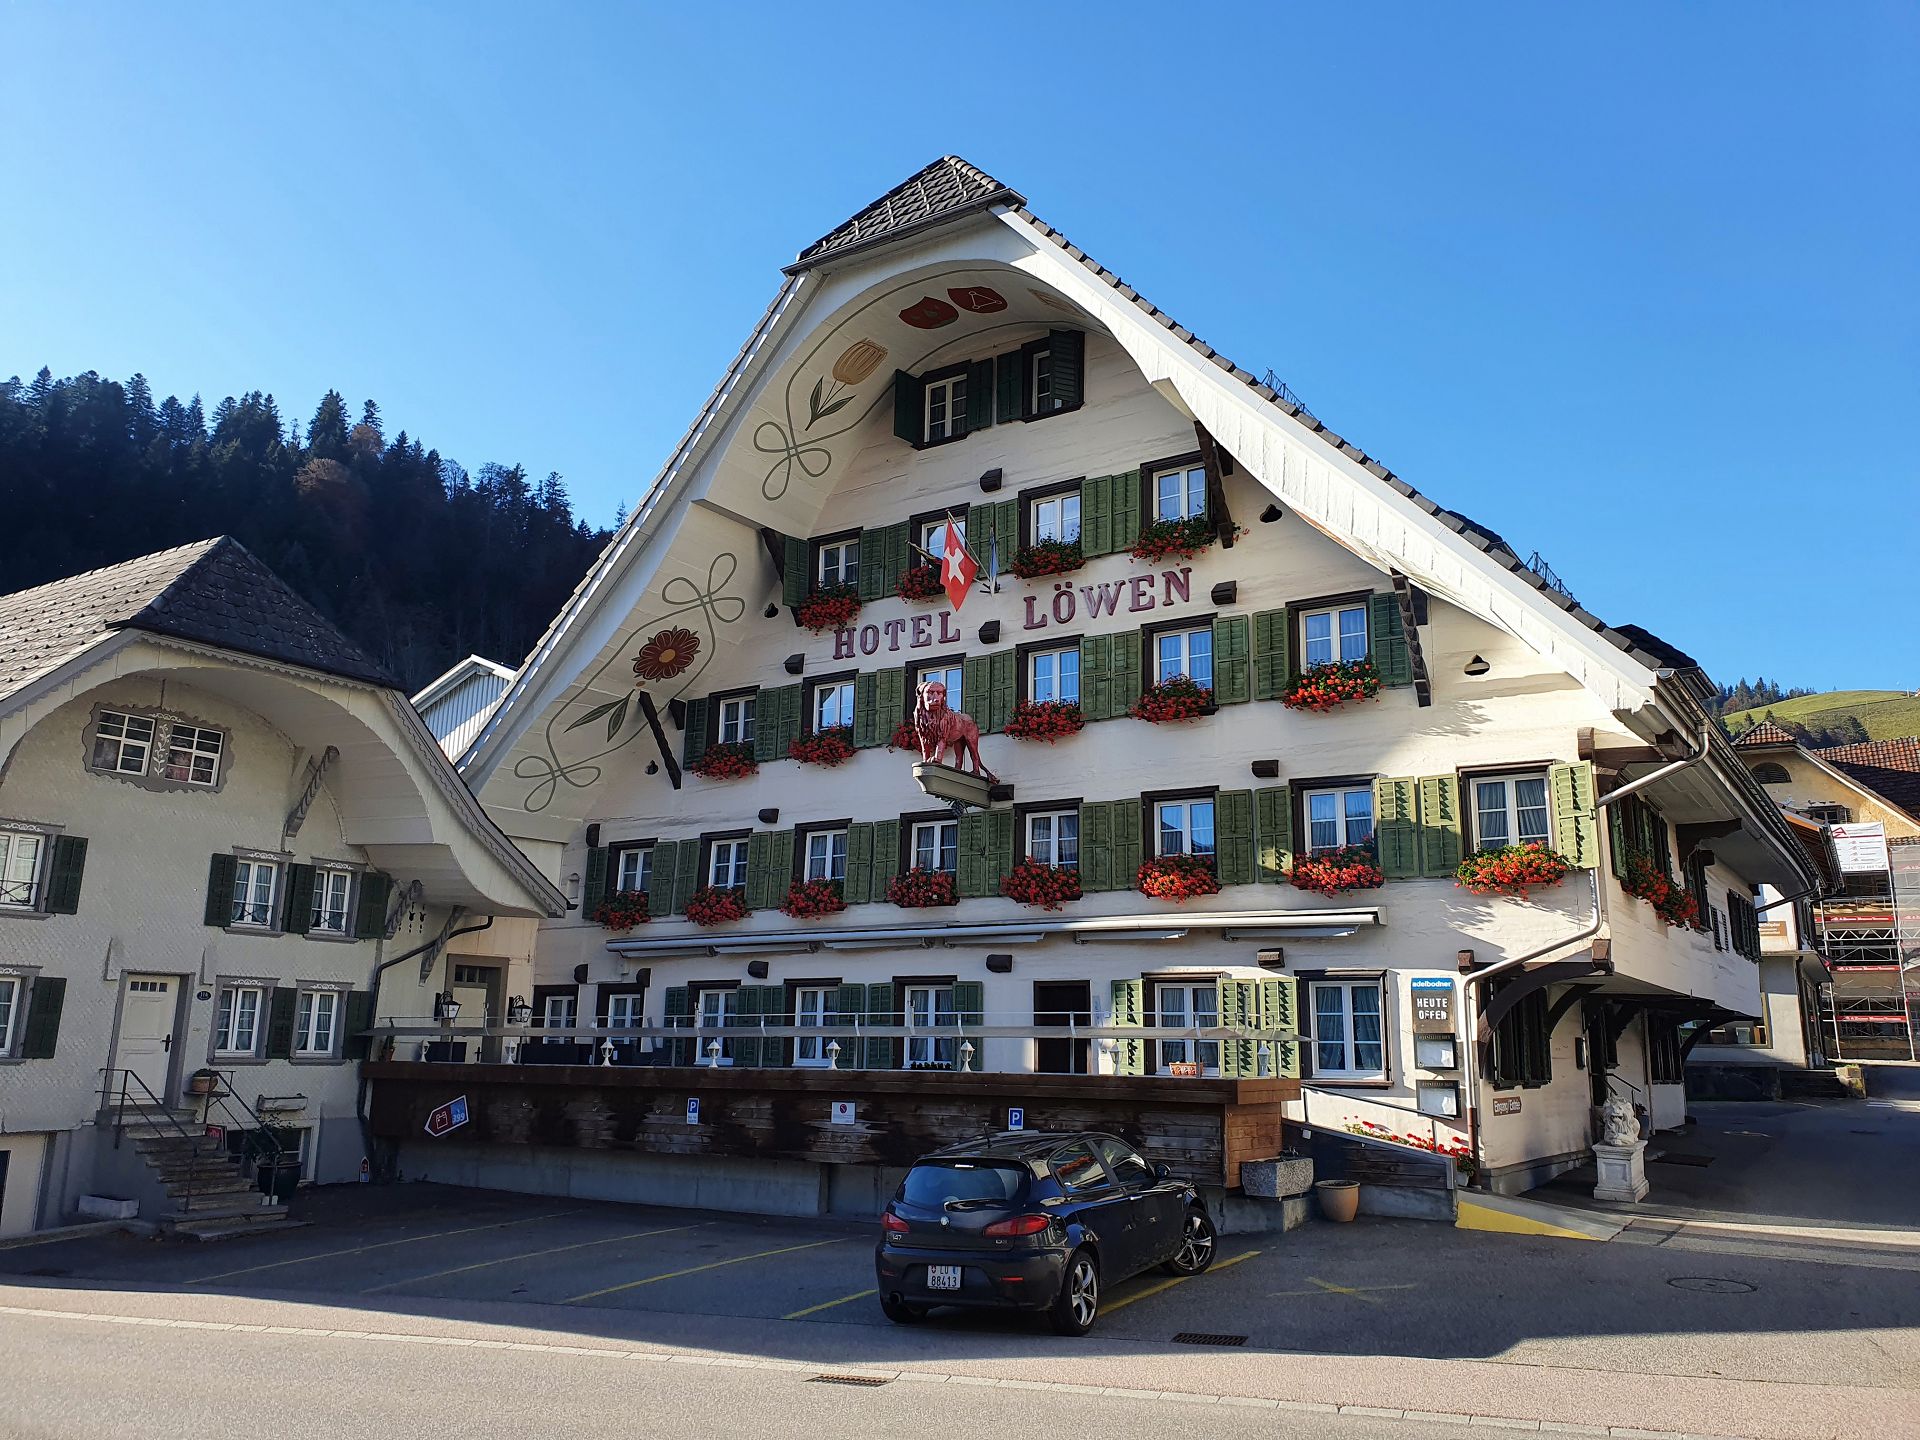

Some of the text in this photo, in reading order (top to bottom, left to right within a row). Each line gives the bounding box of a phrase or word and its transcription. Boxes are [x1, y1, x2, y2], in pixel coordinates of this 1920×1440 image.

[832, 567, 1193, 661] HOTEL LÖWEN
[1416, 998, 1448, 1008] HEUTE
[690, 1101, 697, 1112] P
[1012, 1111, 1020, 1125] P
[940, 1265, 949, 1275] LU
[931, 1276, 957, 1287] 88413
